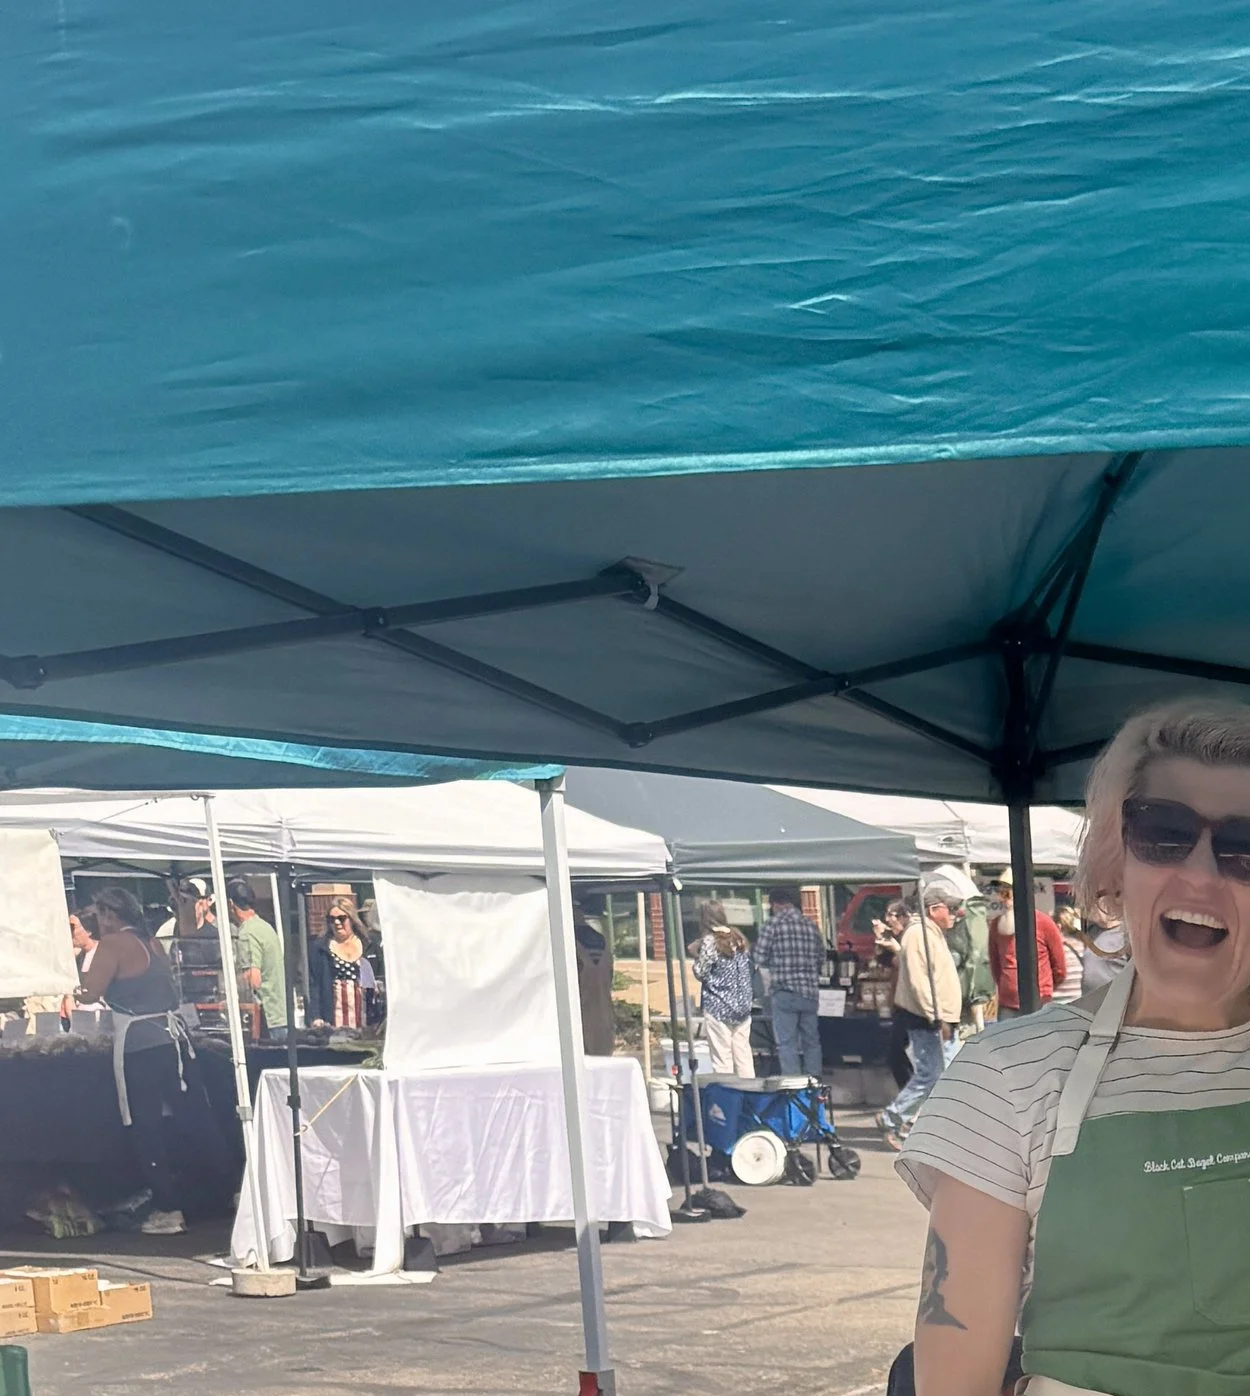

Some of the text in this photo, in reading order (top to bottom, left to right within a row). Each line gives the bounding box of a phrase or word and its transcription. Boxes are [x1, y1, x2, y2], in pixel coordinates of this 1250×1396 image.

[1143, 1160, 1170, 1173] Black
[1170, 1158, 1187, 1170] Cat
[1187, 1154, 1216, 1170] Bagel
